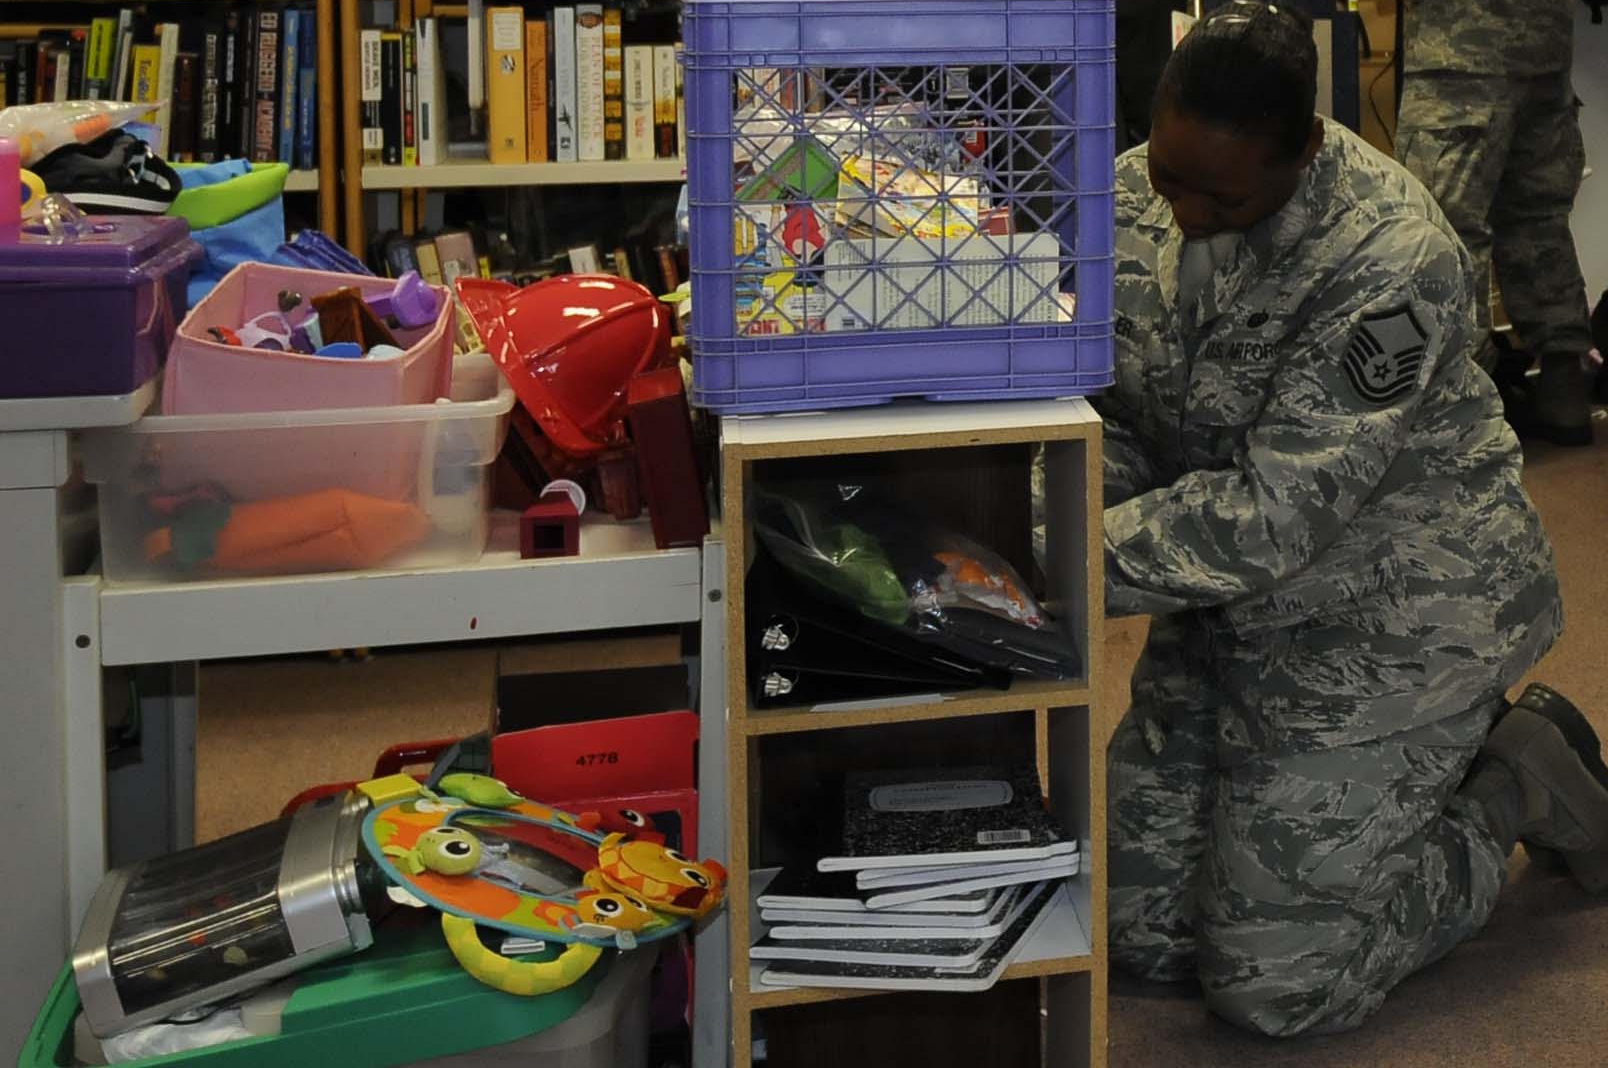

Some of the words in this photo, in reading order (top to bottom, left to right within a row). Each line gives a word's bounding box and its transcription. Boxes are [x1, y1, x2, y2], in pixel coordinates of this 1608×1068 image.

[591, 37, 603, 67] PLAN
[530, 58, 546, 112] Namath
[591, 72, 603, 89] OF
[592, 92, 604, 139] ATTACK
[1245, 341, 1280, 361] FORC
[575, 751, 619, 767] 4778
